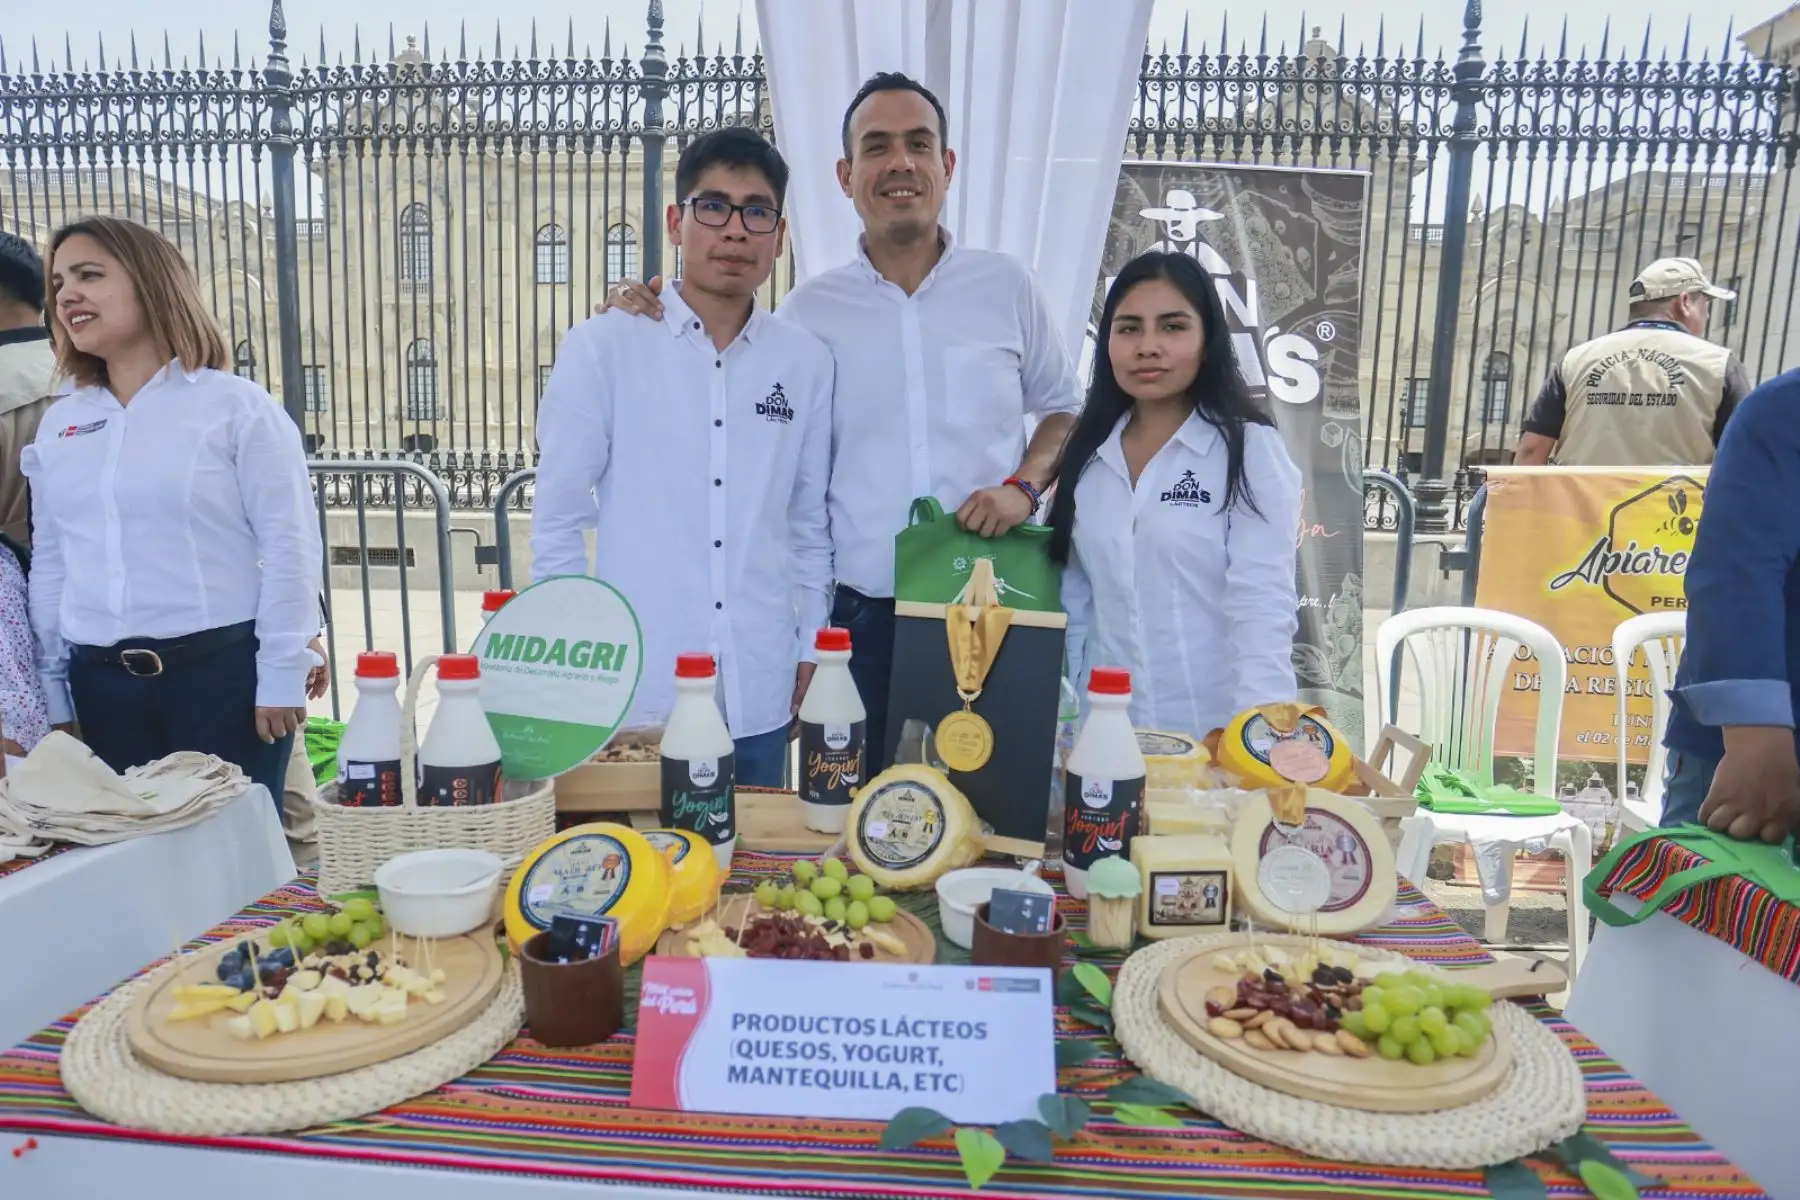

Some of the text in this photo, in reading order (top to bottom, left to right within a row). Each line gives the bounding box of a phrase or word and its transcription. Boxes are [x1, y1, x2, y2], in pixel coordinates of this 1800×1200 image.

[1636, 348, 1685, 389] NACIONAL
[755, 402, 794, 421] DIMAS
[766, 396, 789, 408] DON
[1586, 392, 1677, 407] SEGURIDAD DEL ESTADO
[1160, 490, 1211, 503] DIMAS
[1173, 482, 1200, 491] DON
[1550, 537, 1687, 590] Apiare
[1650, 596, 1688, 608] PER
[483, 632, 628, 672] MIDAGRI
[808, 748, 862, 790] Yogurt
[672, 784, 731, 832] Yogurt
[731, 1012, 988, 1040] PRODUCTOS LÁCTEOS
[729, 1038, 944, 1067] (QUESOS, YOGURT,
[727, 1065, 966, 1095] MANTEQUILLA, ETC)
